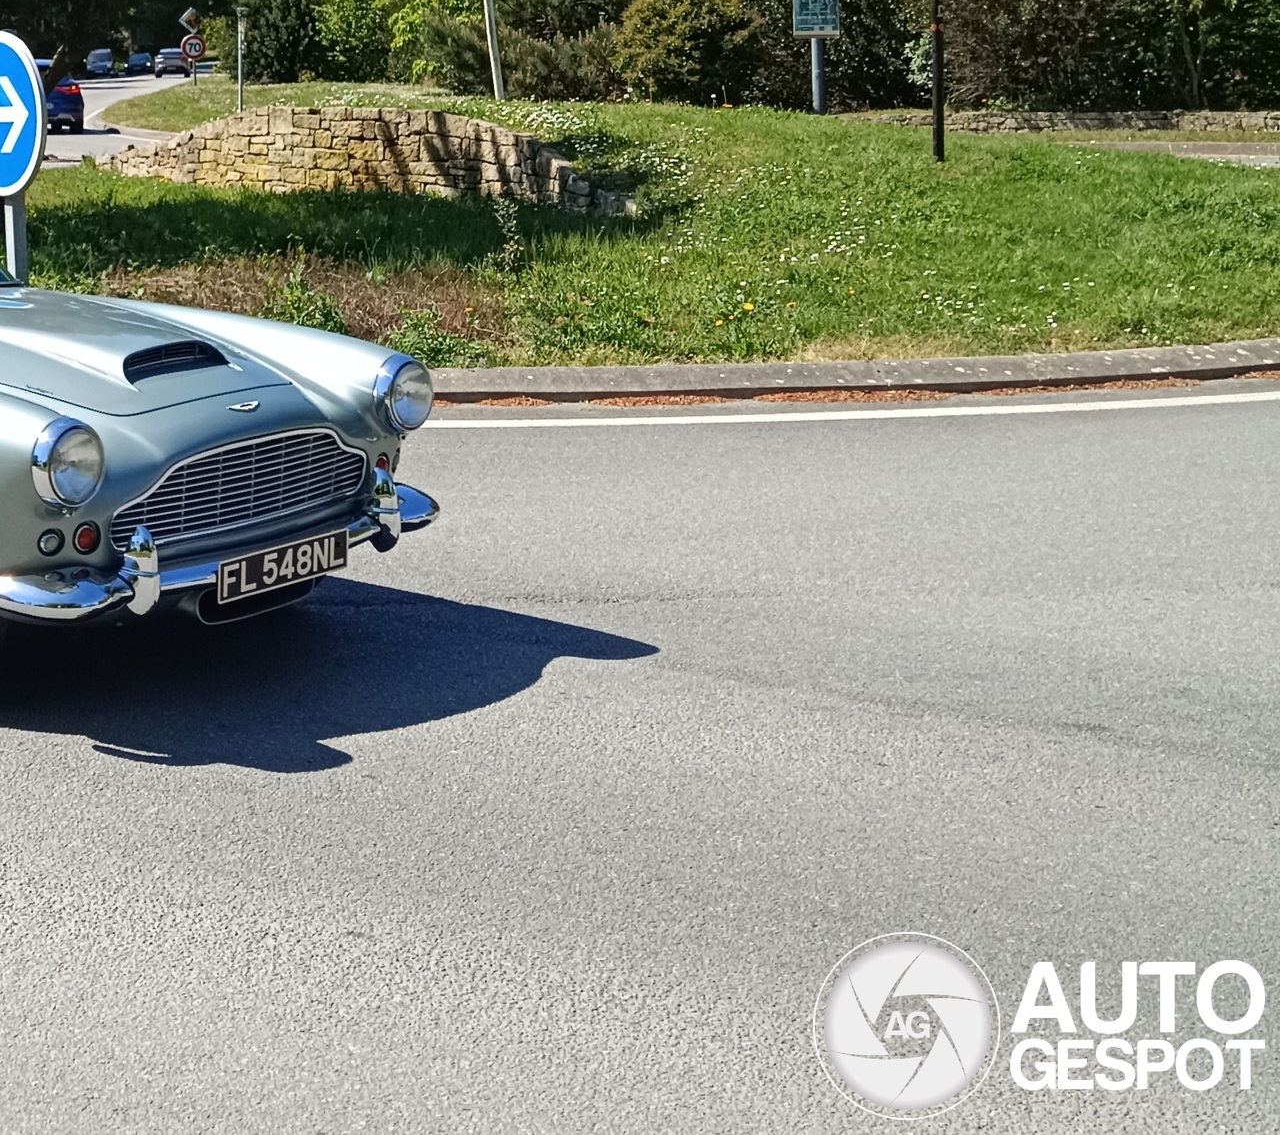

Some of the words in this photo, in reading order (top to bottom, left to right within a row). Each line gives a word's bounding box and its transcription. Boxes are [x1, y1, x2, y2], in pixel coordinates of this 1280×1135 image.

[187, 42, 202, 53] 70
[222, 561, 257, 598] FL
[262, 537, 344, 585] 548NL
